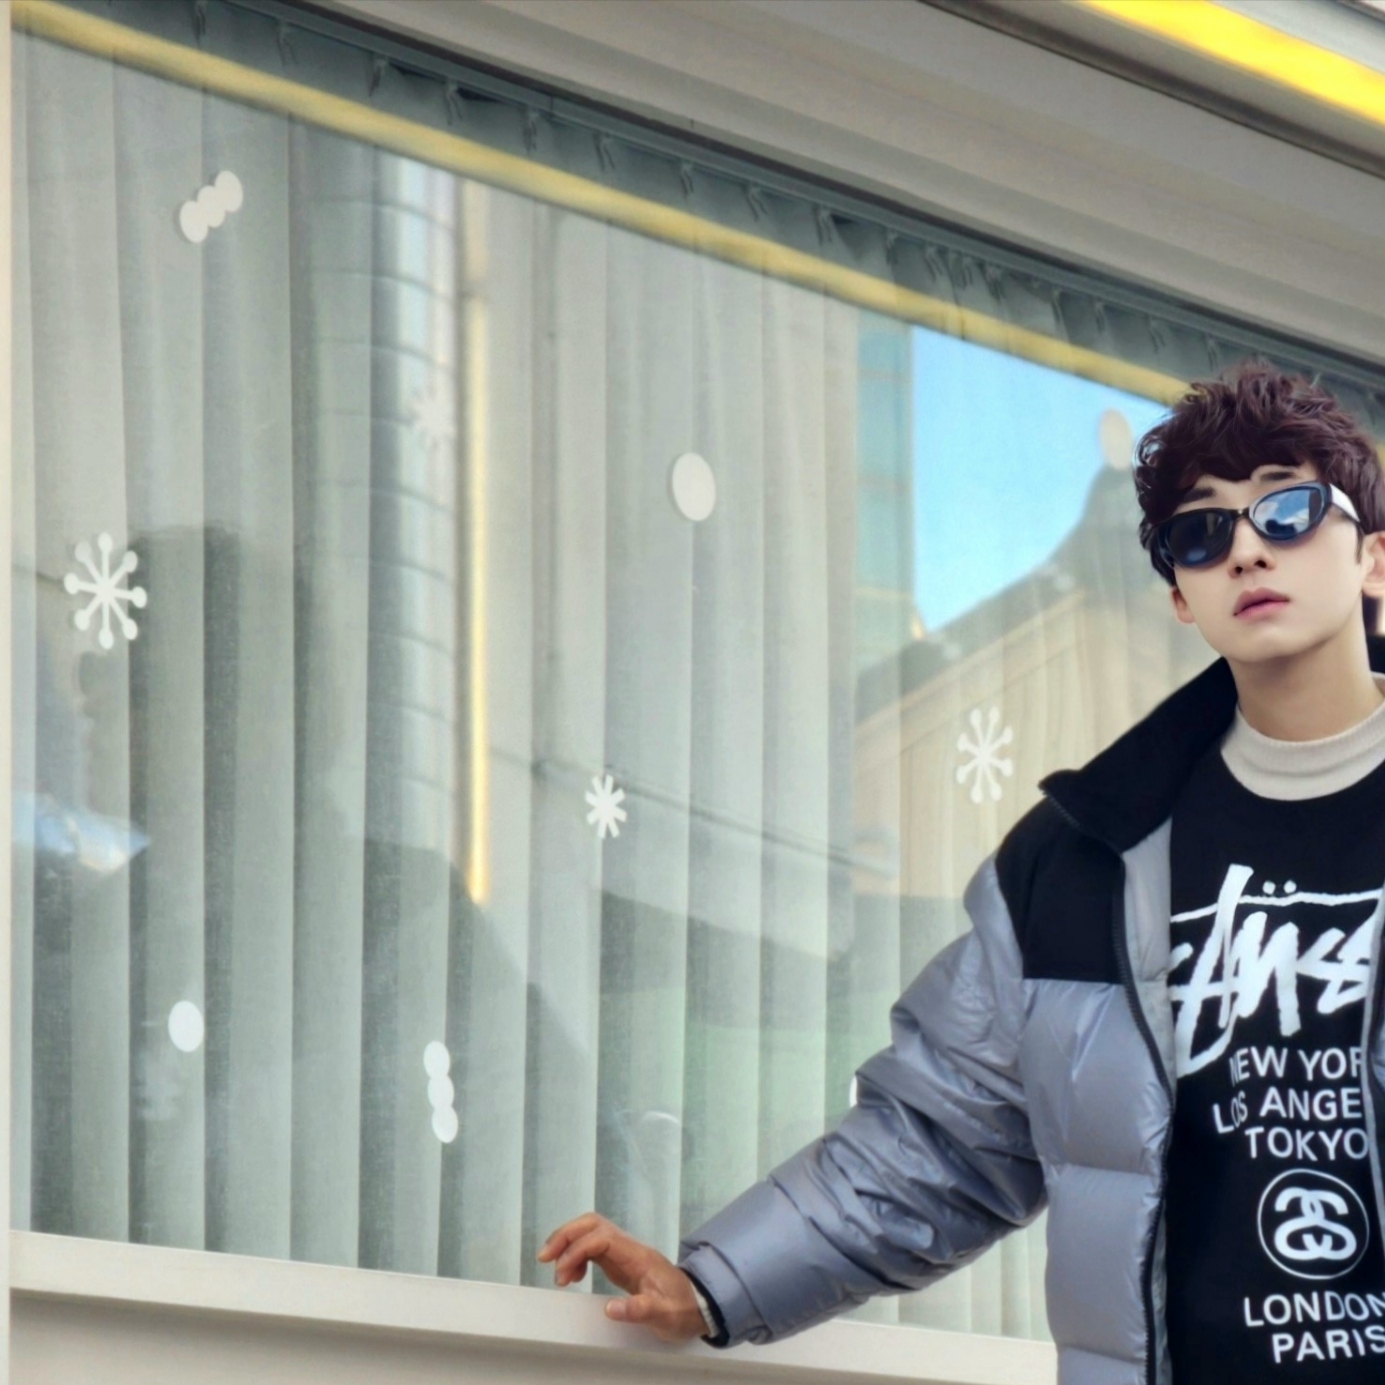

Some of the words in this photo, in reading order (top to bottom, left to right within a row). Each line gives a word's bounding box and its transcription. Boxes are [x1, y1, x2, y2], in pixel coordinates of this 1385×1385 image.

[1229, 1045, 1288, 1087] NEW
[1212, 1090, 1249, 1134] LOS
[1259, 1085, 1362, 1121] ANGE
[1244, 1126, 1369, 1161] TOKYO
